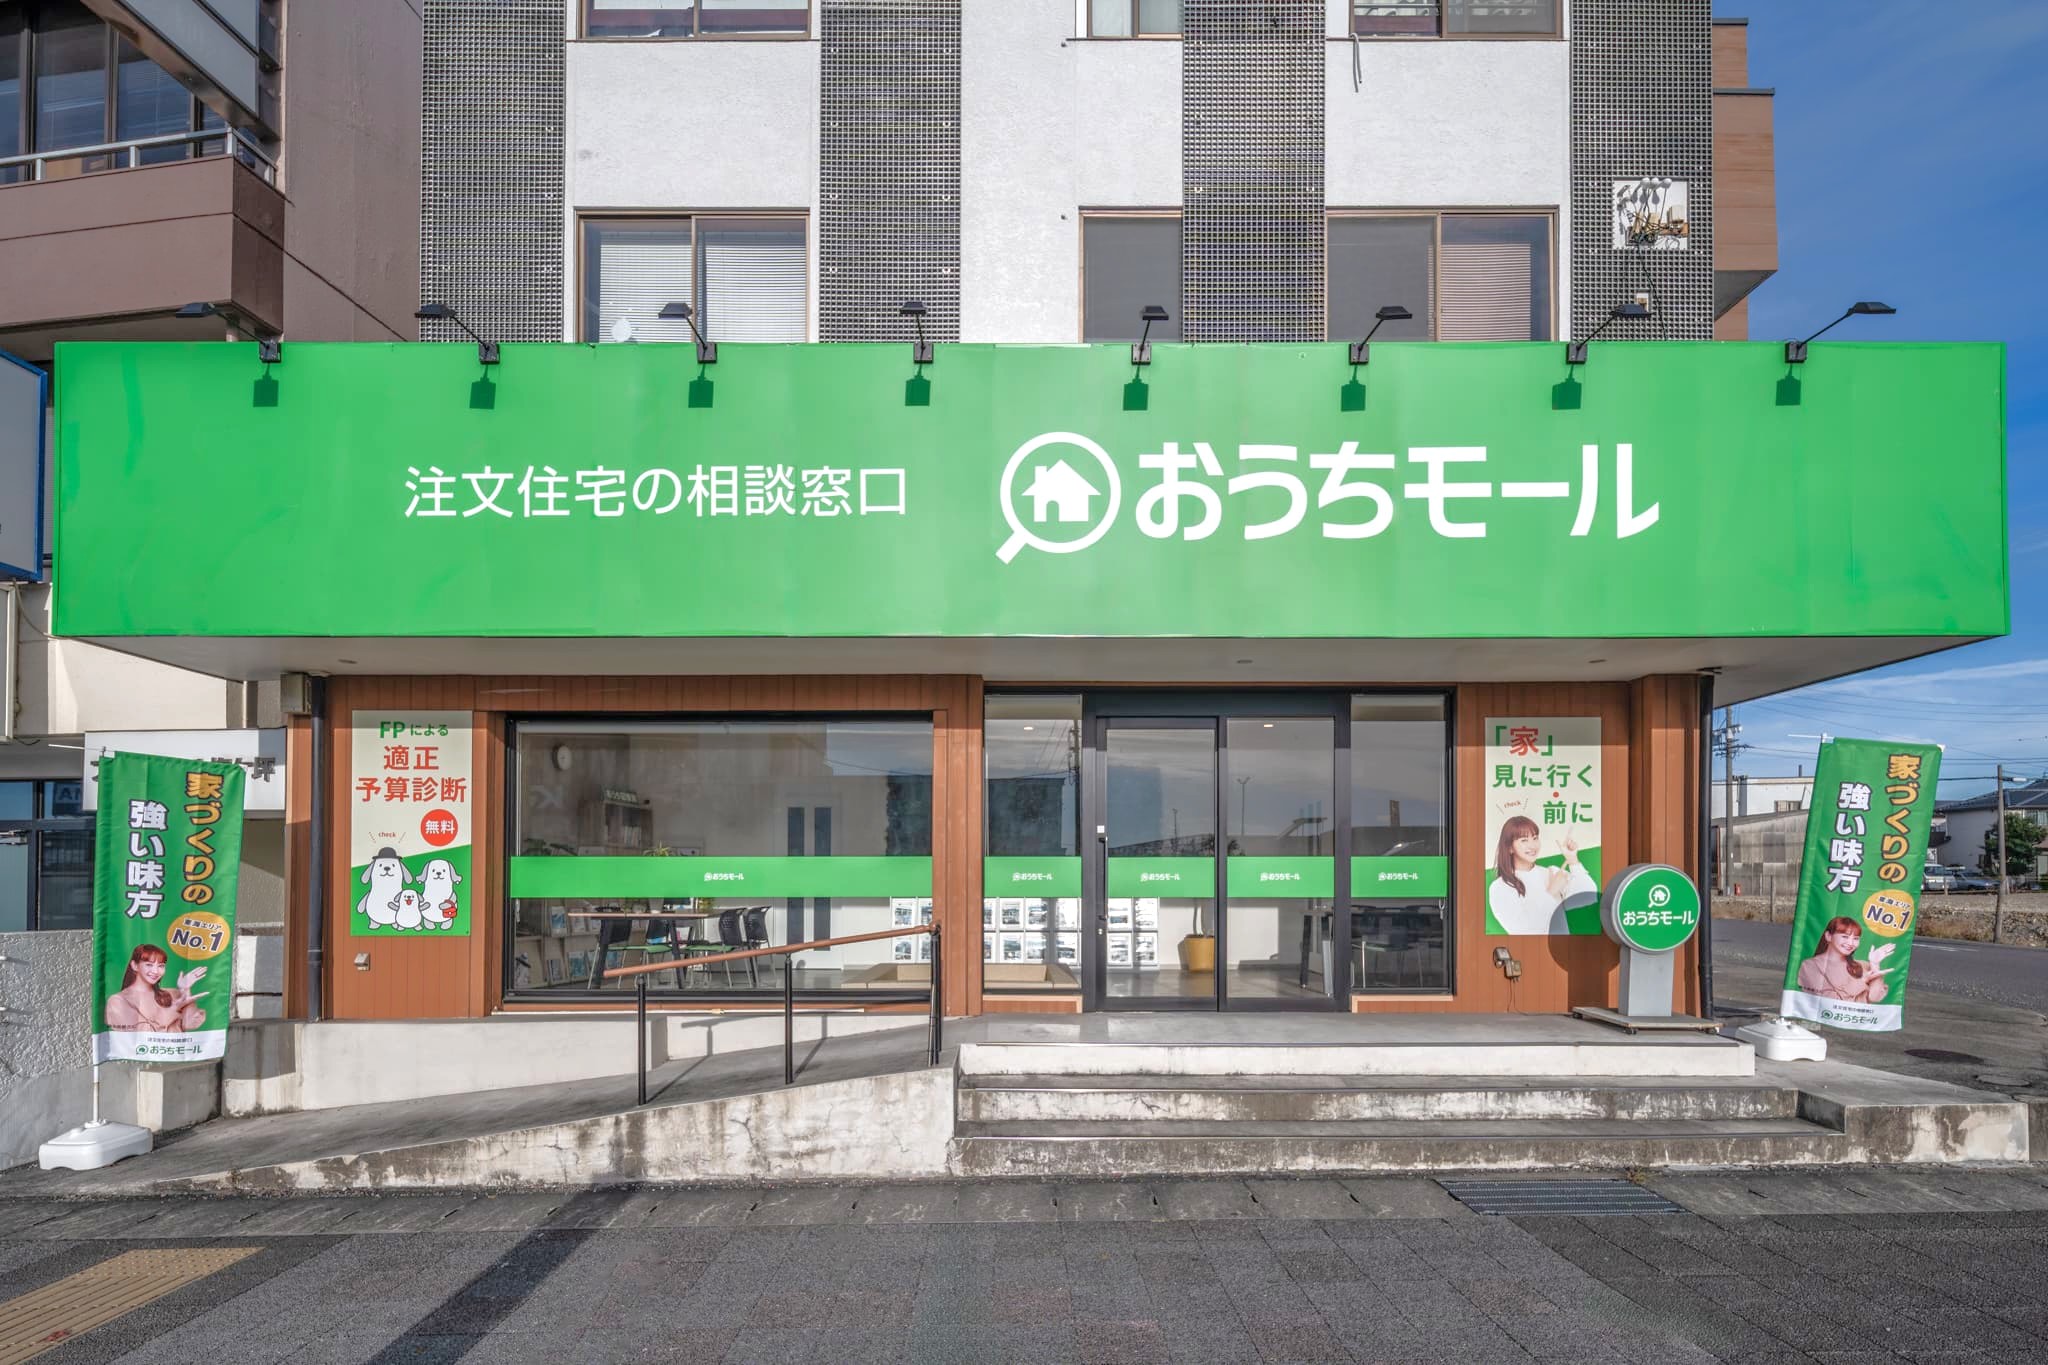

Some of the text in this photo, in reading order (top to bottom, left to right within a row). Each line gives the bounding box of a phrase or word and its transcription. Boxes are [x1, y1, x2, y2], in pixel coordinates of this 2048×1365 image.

[404, 463, 906, 518] 注文住宅の相談窓口
[1136, 441, 1660, 541] おうちモール
[379, 721, 449, 738] FP による
[1495, 725, 1553, 756] 「家」
[383, 745, 439, 770] 適正
[1492, 764, 1593, 788] 見に行く
[356, 777, 467, 802] 予算診断
[1543, 801, 1593, 824] 前に
[1879, 754, 1921, 883] 家づくりの
[182, 771, 224, 905] 家づくりの
[425, 819, 455, 835] 無料
[1825, 782, 1872, 893] 強い味方
[124, 799, 169, 919] 強い味方
[712, 872, 744, 881] おうちモール
[1022, 872, 1054, 881] おうちモール
[1149, 872, 1181, 881] おうちモール
[1268, 872, 1300, 881] おうちモール
[1386, 872, 1418, 881] おうちモール
[1622, 910, 1695, 926] おうちモール
[1867, 905, 1911, 929] No.1
[172, 928, 223, 952] No.1
[1834, 1012, 1878, 1025] おうちモール
[149, 1044, 202, 1056] おうちモール
